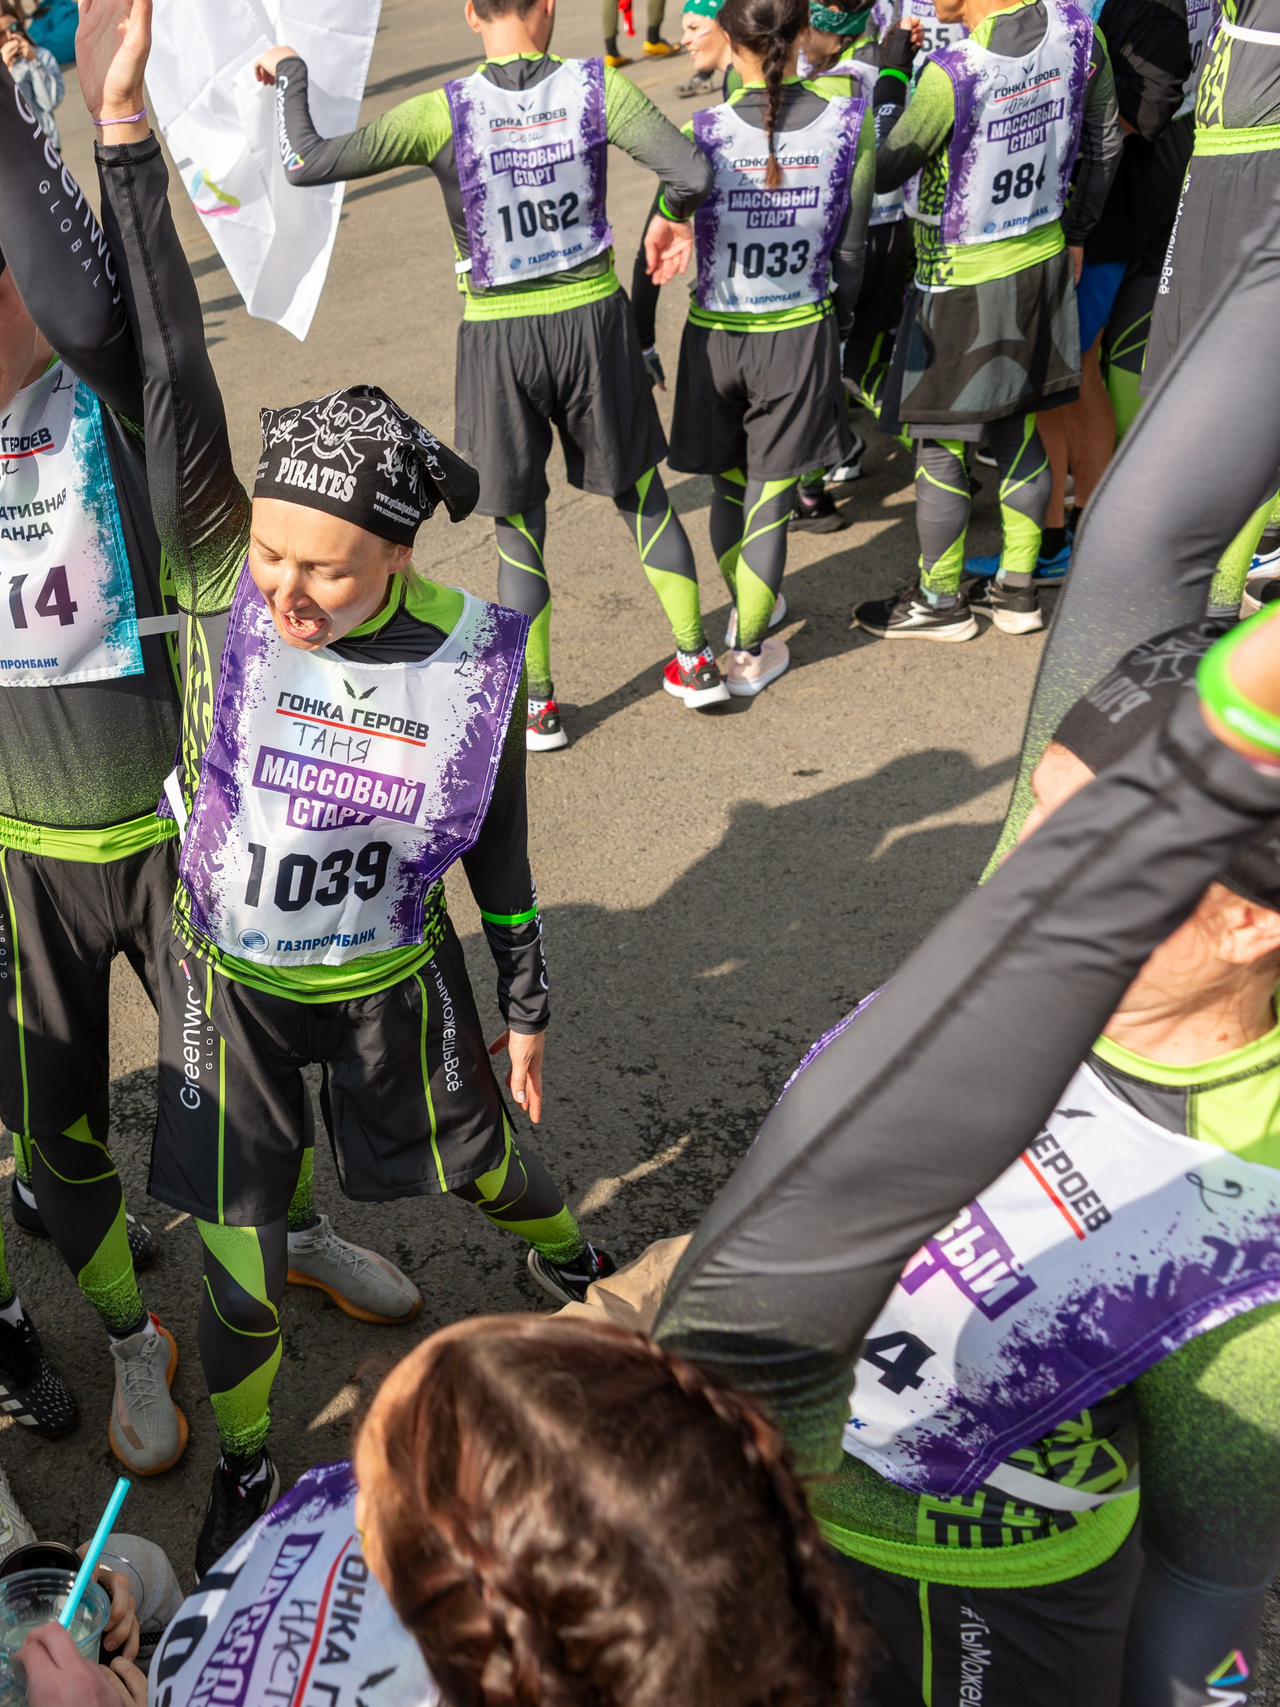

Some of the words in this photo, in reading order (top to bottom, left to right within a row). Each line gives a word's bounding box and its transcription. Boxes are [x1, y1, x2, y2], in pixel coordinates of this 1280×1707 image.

[994, 82, 1026, 99] ГОНКА
[1029, 67, 1061, 87] ГЕРОЕВ
[489, 116, 522, 130] ГОНКА
[526, 108, 567, 126] ГЕРОЕВ
[990, 99, 1062, 138] МАССОВЫЙ
[492, 142, 572, 172] МАССОВЫЙ
[1010, 129, 1046, 152] СТАРТ
[14, 83, 122, 305] Greenwa
[514, 166, 553, 185] СТАРТ
[730, 187, 817, 208] МАССОВЫЙ
[39, 179, 102, 288] GLOBAL
[498, 192, 579, 243] 1062
[749, 209, 795, 227] СТАРТ
[727, 239, 810, 279] 1033
[0, 426, 53, 454] ГЕРОЕВ
[275, 456, 357, 503] PIRATES
[453, 650, 474, 678] 2
[277, 691, 344, 724] ГОНКА
[350, 708, 430, 741] ГЕРОЕВ
[293, 721, 373, 764] ТАНЯ
[259, 754, 418, 818] МАССОВЫЙ
[292, 797, 370, 828] СТАРТ
[244, 841, 393, 912] 1039
[276, 927, 376, 952] ГАЗПРОМБАНК
[205, 1025, 214, 1070] GLOB
[1027, 1124, 1112, 1233] ЕРОЕВ
